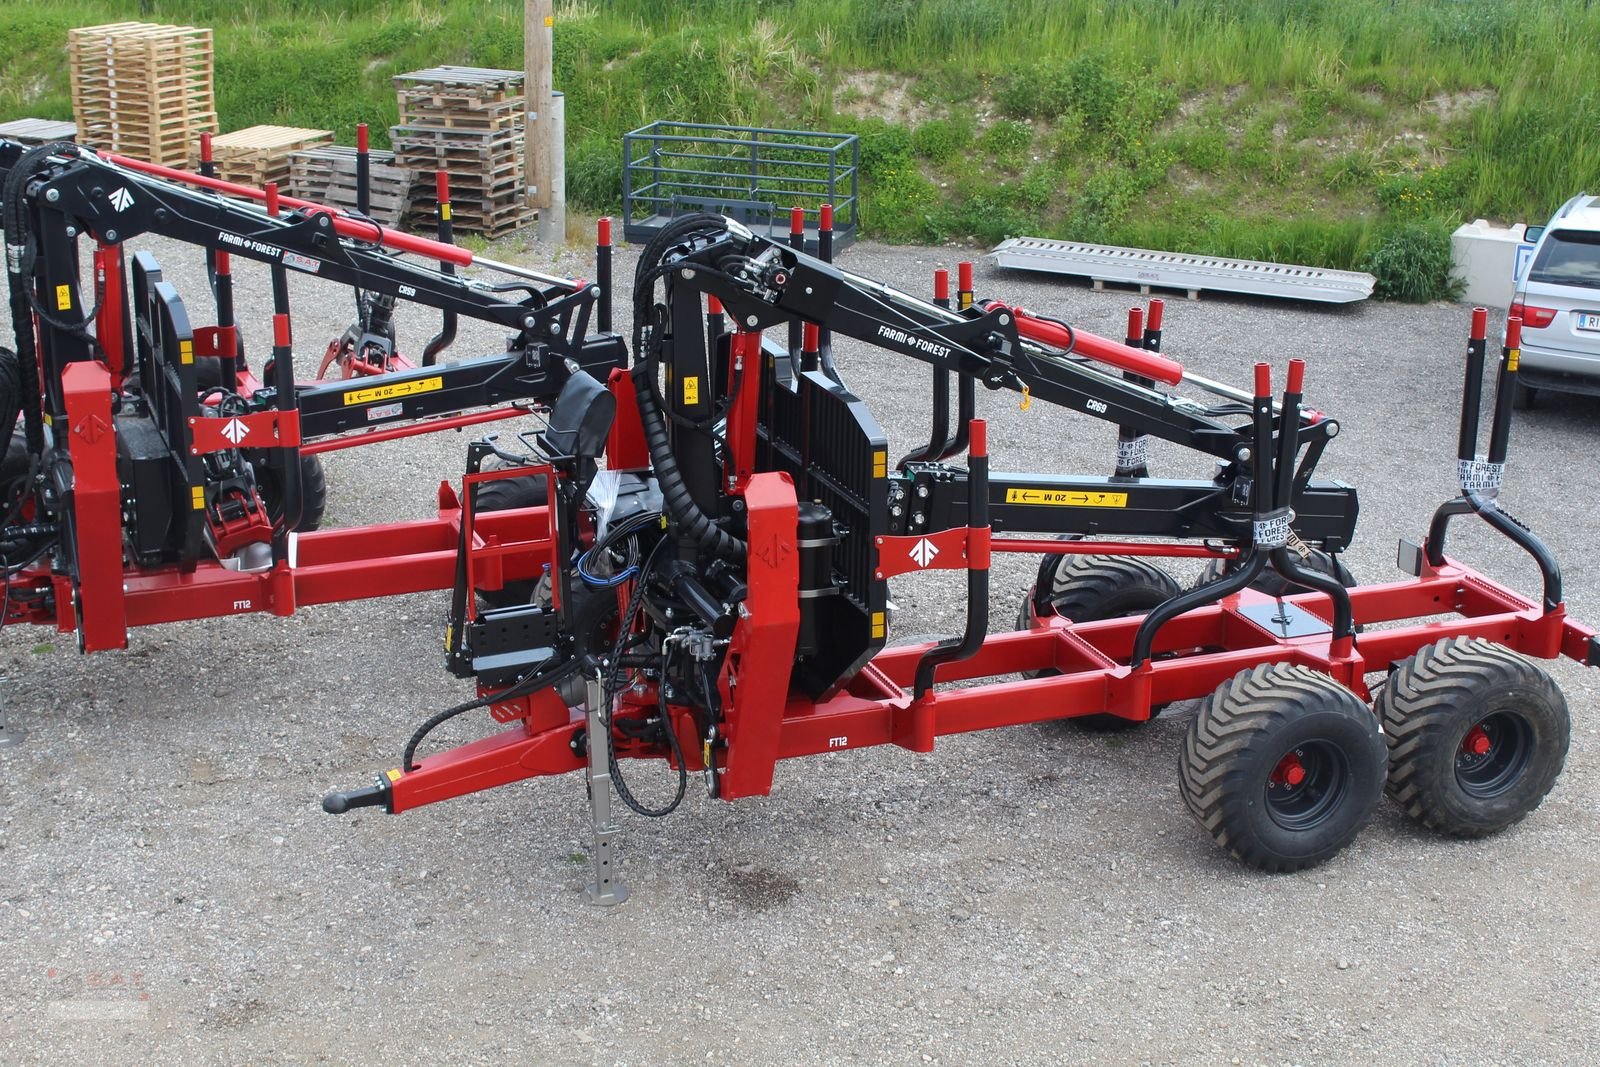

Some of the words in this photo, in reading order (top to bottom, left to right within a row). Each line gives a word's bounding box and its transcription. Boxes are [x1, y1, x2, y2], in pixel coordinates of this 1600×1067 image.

[218, 231, 244, 247] FARMI
[251, 241, 281, 257] FOREST
[878, 325, 908, 344] FARMI
[915, 338, 951, 358] FOREST
[1086, 398, 1107, 414] CR69
[1463, 481, 1494, 489] FARMI
[1043, 493, 1052, 501] M
[1054, 494, 1067, 502] 20
[233, 599, 251, 610] FT12
[829, 736, 848, 748] FT12
